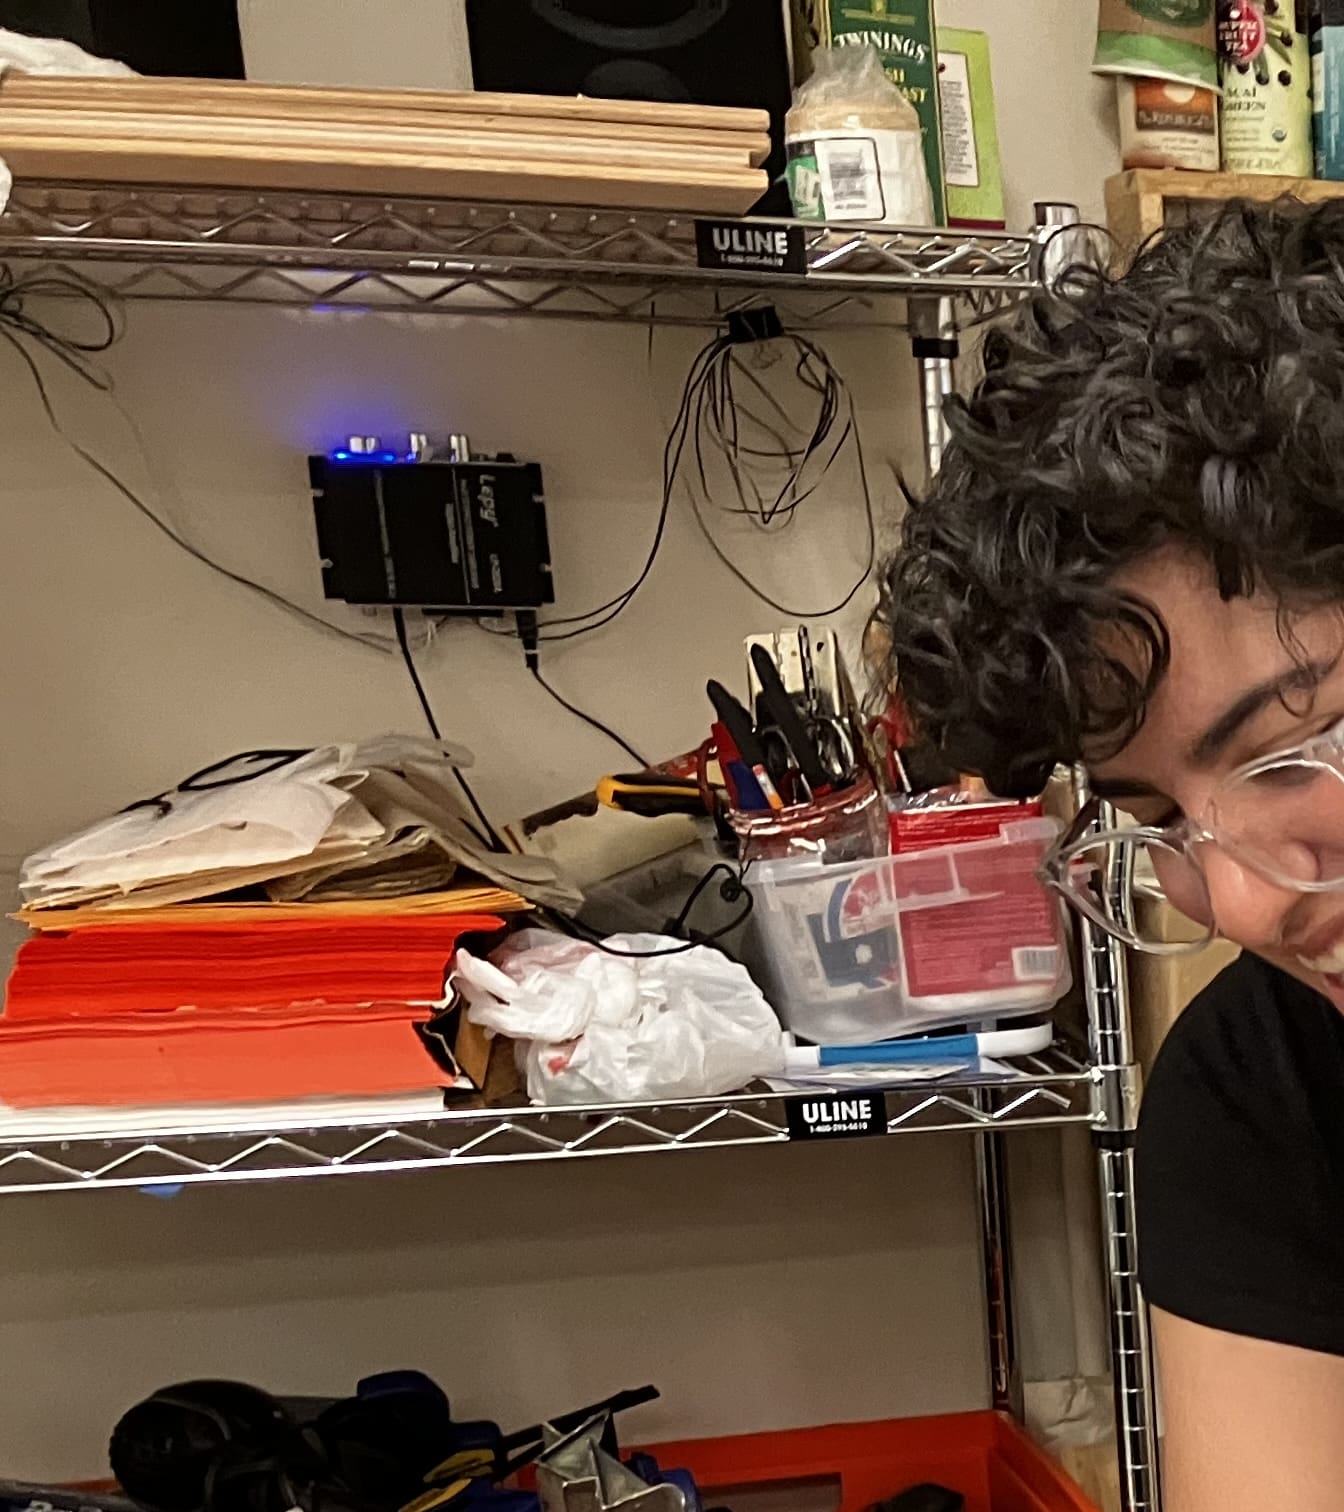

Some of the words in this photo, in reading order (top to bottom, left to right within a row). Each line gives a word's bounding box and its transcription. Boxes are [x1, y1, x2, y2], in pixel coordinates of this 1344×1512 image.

[833, 30, 931, 65] TWININGS
[712, 227, 788, 255] ULINE
[802, 1099, 872, 1124] ULINE
